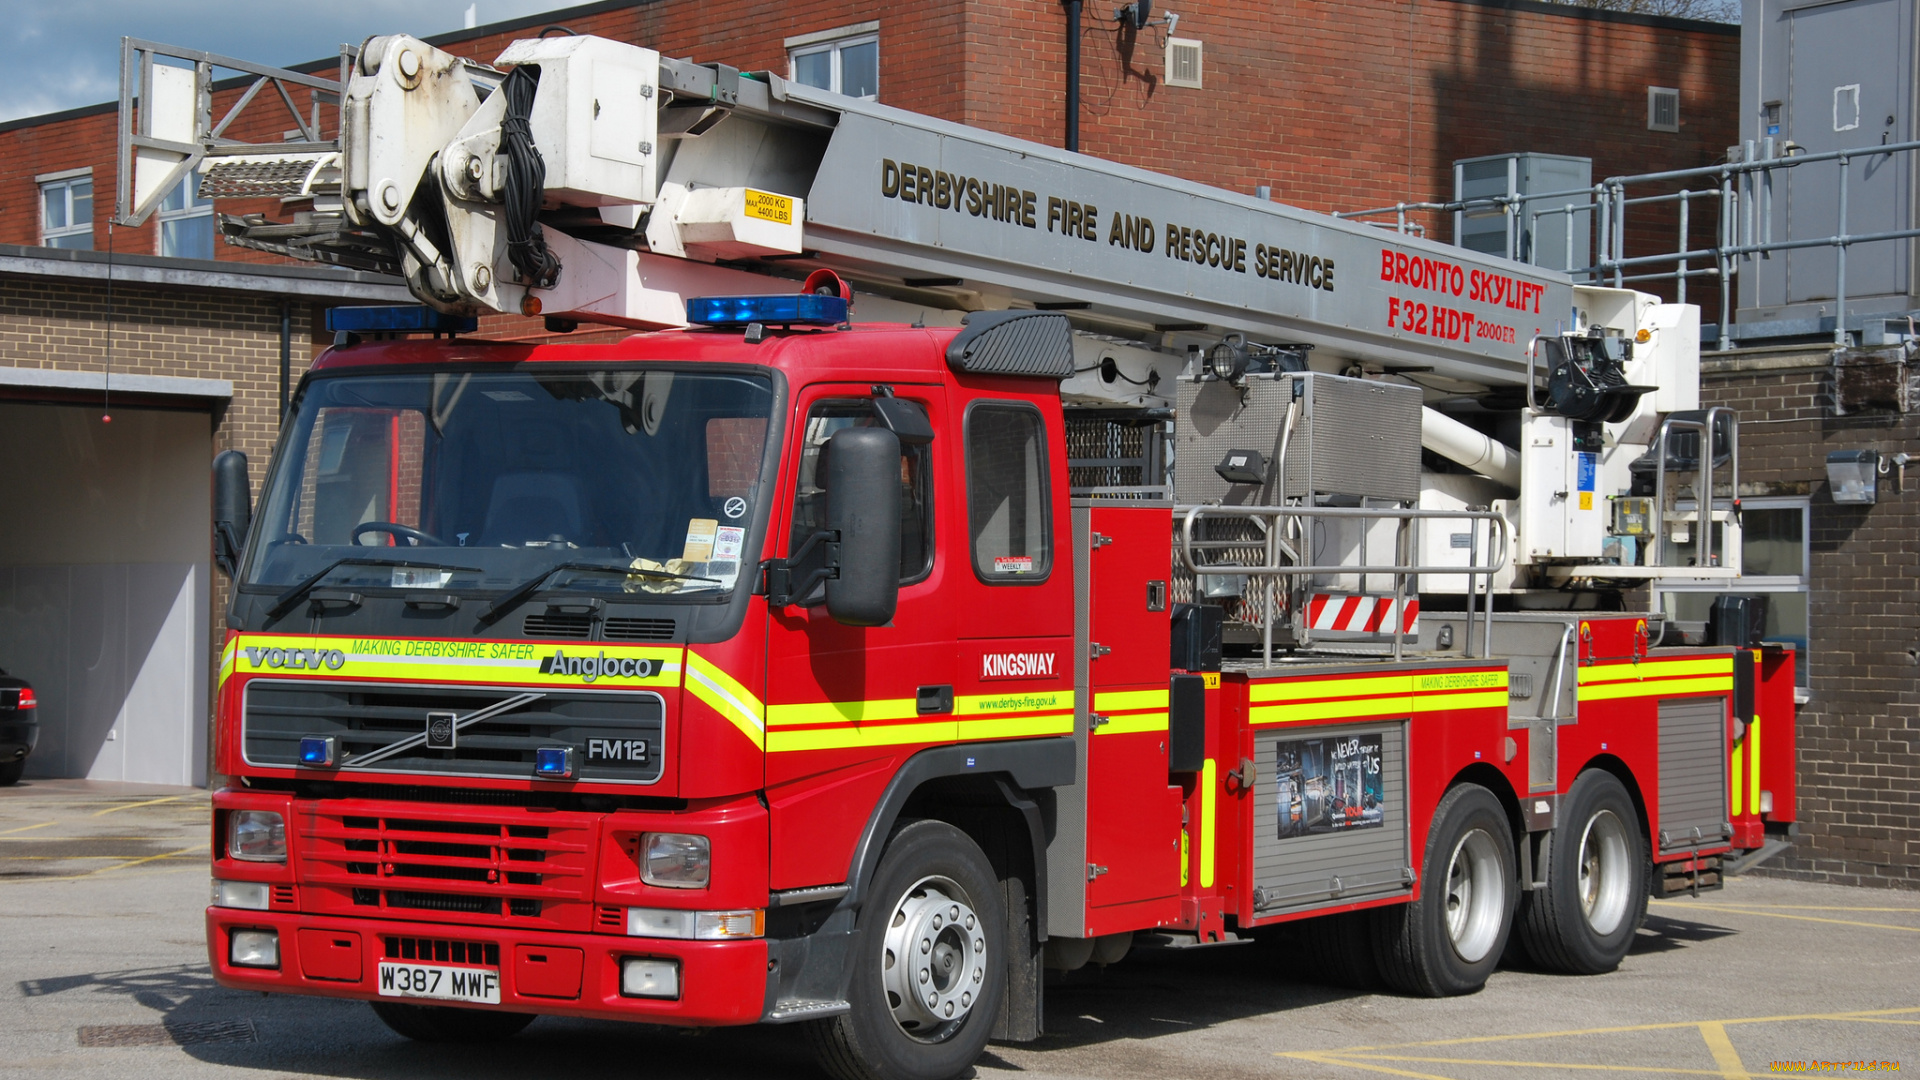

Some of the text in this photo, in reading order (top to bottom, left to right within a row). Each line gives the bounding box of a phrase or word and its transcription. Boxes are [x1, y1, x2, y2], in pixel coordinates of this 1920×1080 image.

[758, 195, 785, 209] 2000 KG
[758, 207, 788, 221] 4400 LBS
[882, 158, 1335, 292] DERBYSHIRE FIRE AND RESCUE SERVICE
[1381, 249, 1544, 314] BRONTO SKYLIFT
[245, 646, 345, 670] VOLVO
[351, 639, 534, 660] MAKING DERBYSHIRE SAFER
[549, 649, 652, 682] Angloco
[983, 653, 1055, 676] KINGSWAY
[1421, 673, 1498, 689] MAKING DERBYSHIRE SAFER
[979, 694, 1056, 710] www.derbys-fire.gov.uk
[588, 739, 646, 761] FM12
[1336, 739, 1360, 759] NEVER
[1367, 754, 1380, 774] US
[381, 966, 497, 998] W387 MWF
